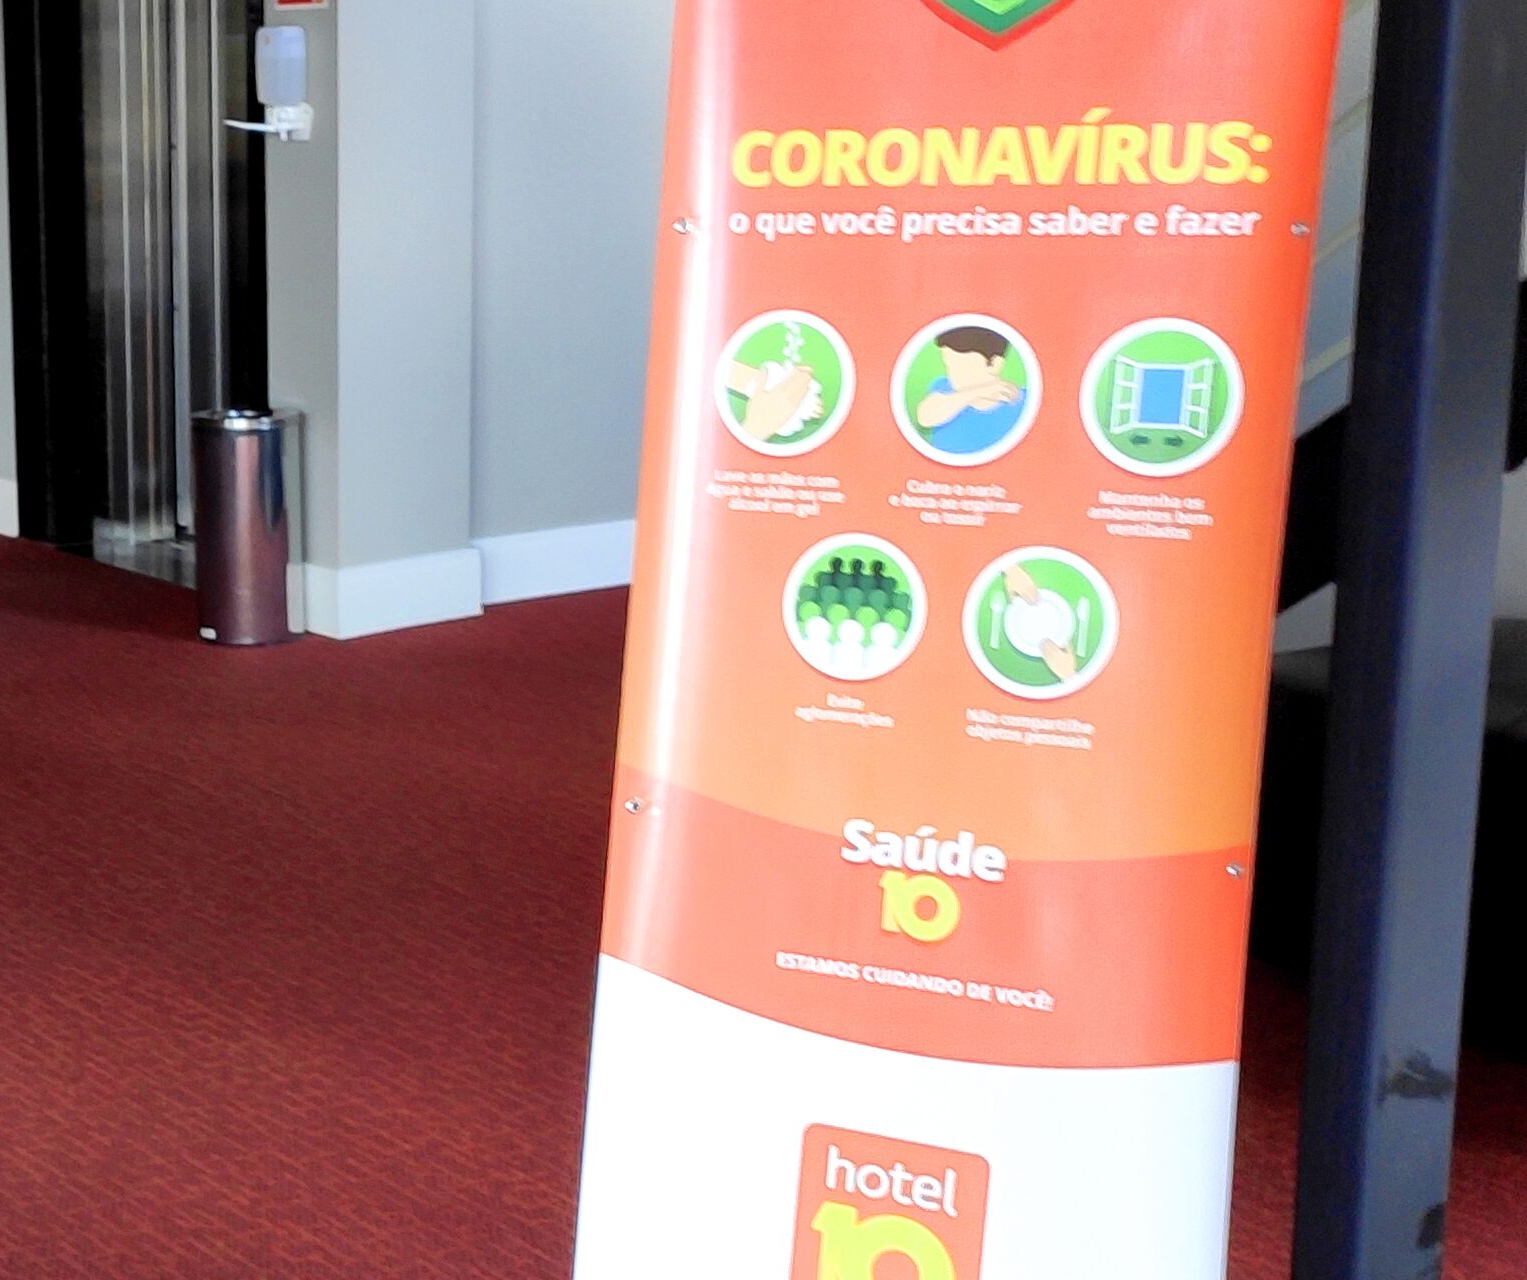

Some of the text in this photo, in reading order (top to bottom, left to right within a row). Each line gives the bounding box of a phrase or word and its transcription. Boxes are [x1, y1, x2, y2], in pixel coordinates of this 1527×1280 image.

[732, 107, 1272, 187] CORONAVÍRUS:
[728, 204, 1263, 243] o que você precisa saber e fazer
[841, 818, 1007, 882] Saúde
[878, 870, 961, 942] 10
[776, 951, 861, 980] ESTAMOS
[862, 965, 965, 997] CUIDANDO
[966, 982, 991, 1002] DE
[825, 1144, 958, 1218] hotel
